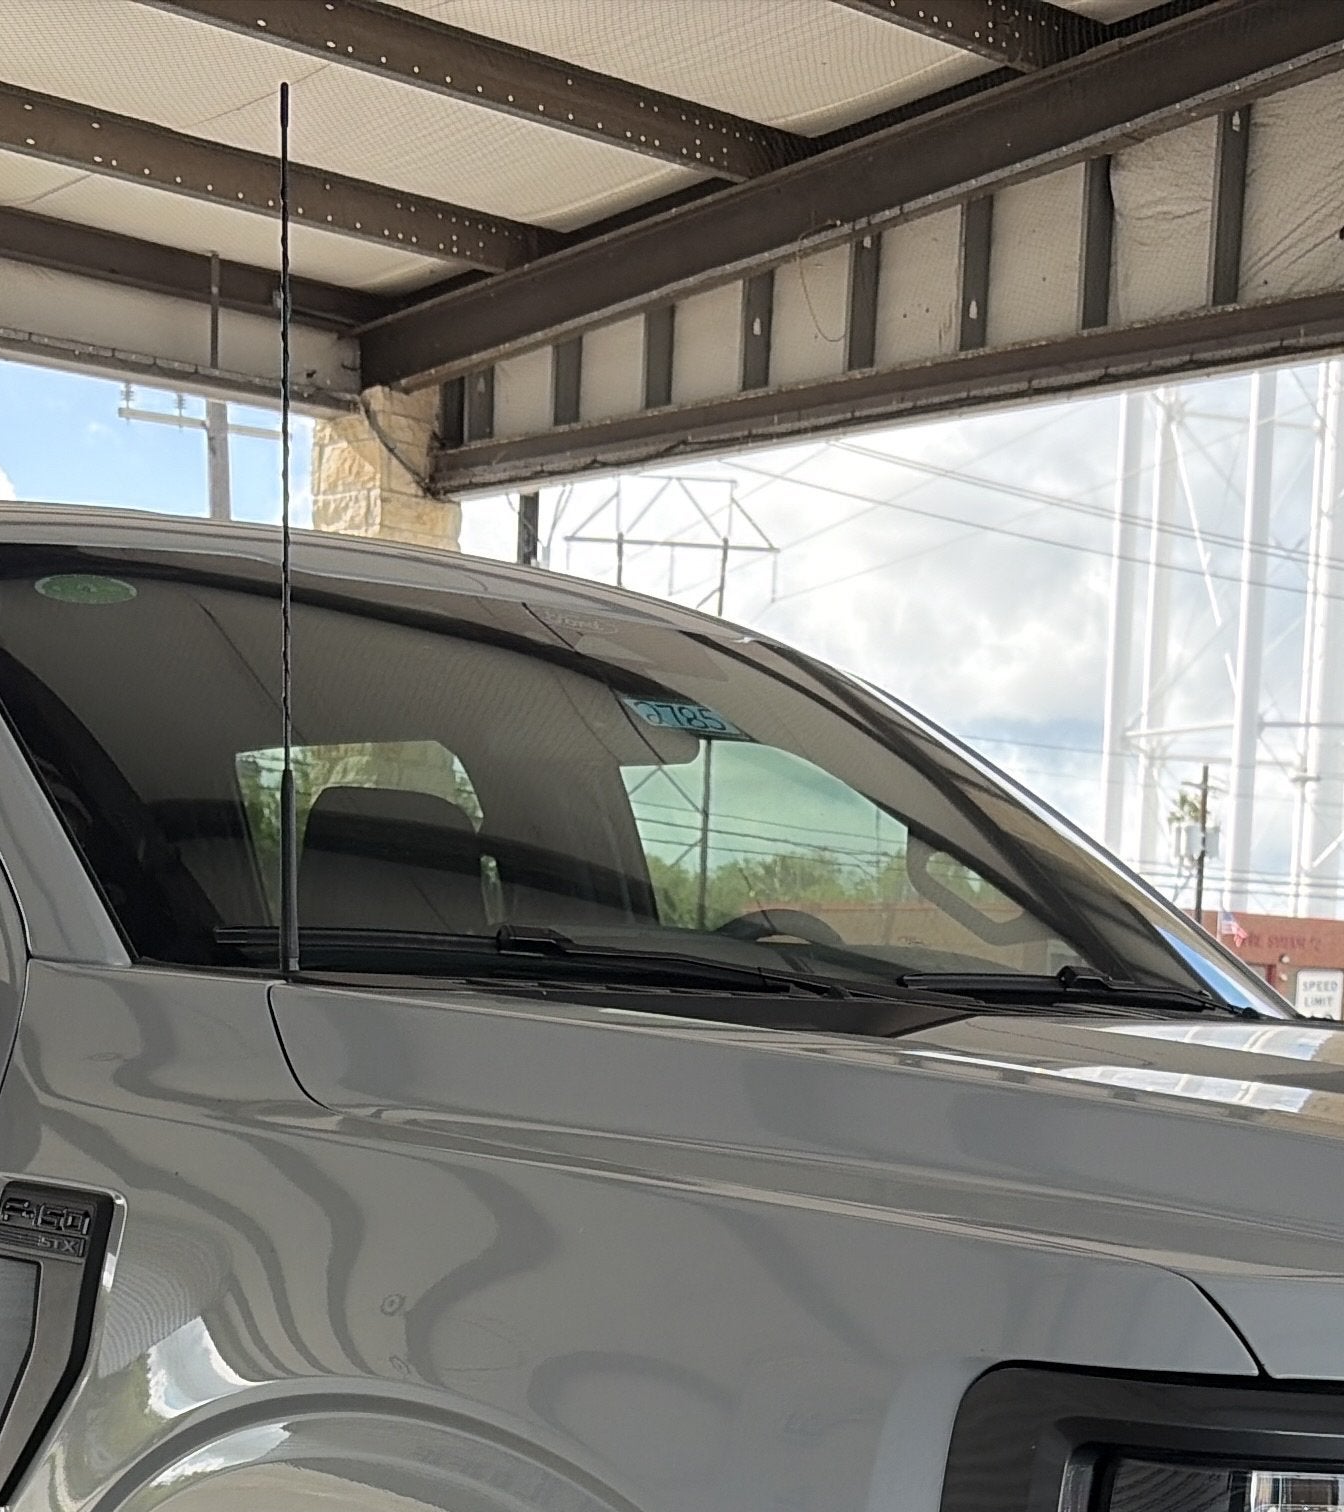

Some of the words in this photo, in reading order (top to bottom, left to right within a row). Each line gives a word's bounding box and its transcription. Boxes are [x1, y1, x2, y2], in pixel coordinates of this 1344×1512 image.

[634, 701, 727, 731] 2785
[1302, 981, 1339, 992] SPEED
[1304, 997, 1334, 1008] LIMIT
[38, 1236, 77, 1253] STX
